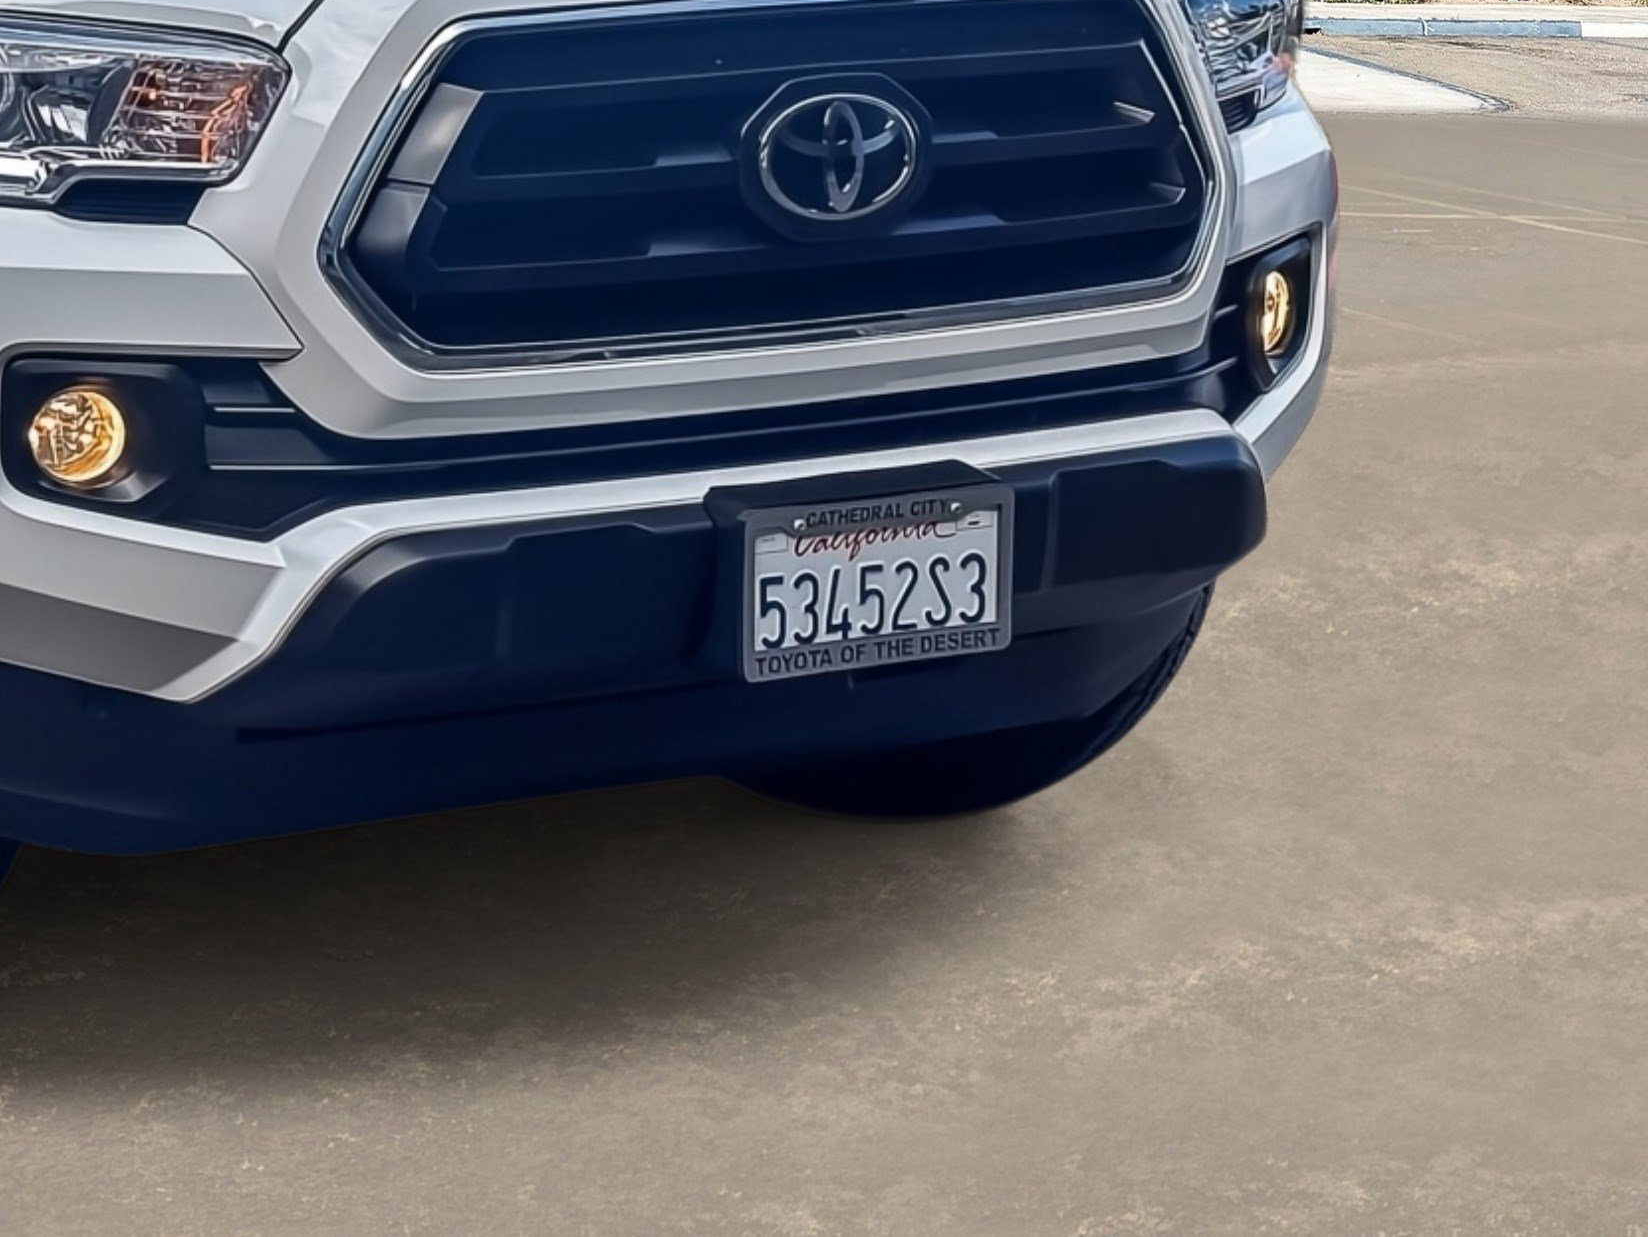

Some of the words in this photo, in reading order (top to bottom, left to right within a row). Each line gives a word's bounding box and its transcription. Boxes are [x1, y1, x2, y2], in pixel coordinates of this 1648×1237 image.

[805, 503, 905, 528] CATHEDRAL
[910, 498, 949, 517] CITY
[759, 552, 987, 650] 53452S3
[755, 649, 833, 677] TOYOTA
[840, 644, 868, 664] OF
[874, 638, 914, 660] THE
[920, 627, 1002, 655] DESERT
